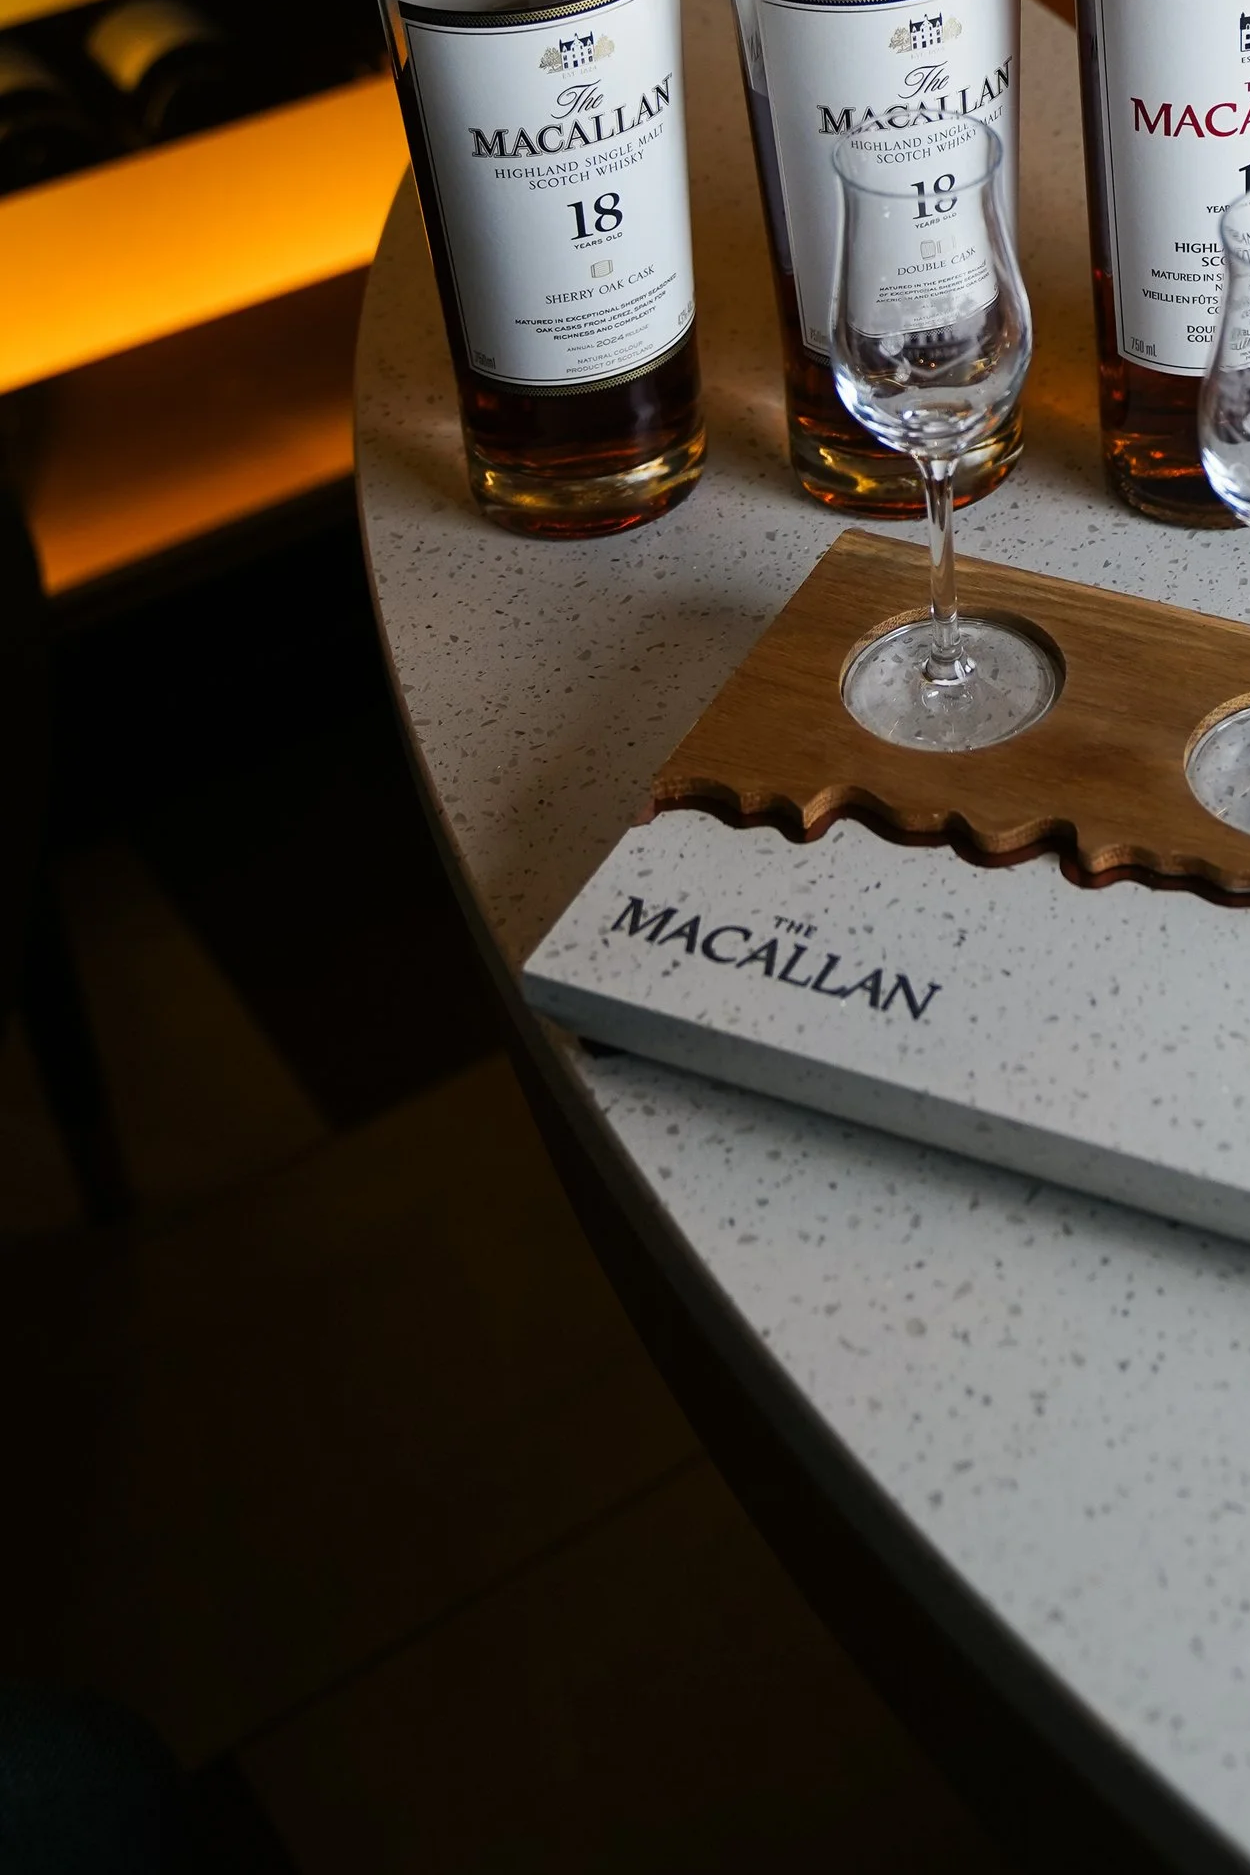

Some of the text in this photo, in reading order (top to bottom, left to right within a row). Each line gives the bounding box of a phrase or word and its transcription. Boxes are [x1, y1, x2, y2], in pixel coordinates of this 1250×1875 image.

[817, 56, 1012, 135] MACALLAN
[898, 61, 950, 99] The
[468, 74, 672, 158] MACALLAN
[551, 79, 604, 119] The
[851, 106, 1004, 151] HIGHLAND SINGLE MALT
[495, 123, 664, 179] HIGHLAND SINGLE MALT
[876, 129, 977, 164] SCOTCH WHISKY
[528, 149, 645, 191] SCOTCH WHISKY
[910, 173, 958, 220] 18
[567, 192, 623, 241] 18
[914, 219, 940, 229] YEARS
[574, 231, 623, 250] YEARS OLD
[897, 247, 976, 276] DOUBLE CASK
[1151, 268, 1202, 282] MATURED
[545, 264, 655, 305] SHERRY OAK CASK
[1142, 289, 1218, 305] VIEILLI EN FÛTS
[554, 323, 582, 333] CASKS
[584, 317, 606, 329] FROM
[634, 301, 654, 314] SPAIN
[654, 291, 667, 304] FOR
[554, 306, 657, 341] RICHNESS AND COMPLEXITY
[555, 317, 563, 325] IN
[566, 307, 620, 323] EXCEPTIONAL
[621, 293, 648, 310] SHERRY
[566, 344, 595, 352] ANNUAL
[596, 333, 624, 348] 2024
[566, 363, 605, 374] PRODUCT
[617, 343, 654, 363] SCOTLAND
[577, 340, 644, 365] NATURAL COLOUR
[1130, 337, 1144, 353] 750
[773, 914, 818, 938] THE
[610, 895, 942, 1021] MACALLAN
